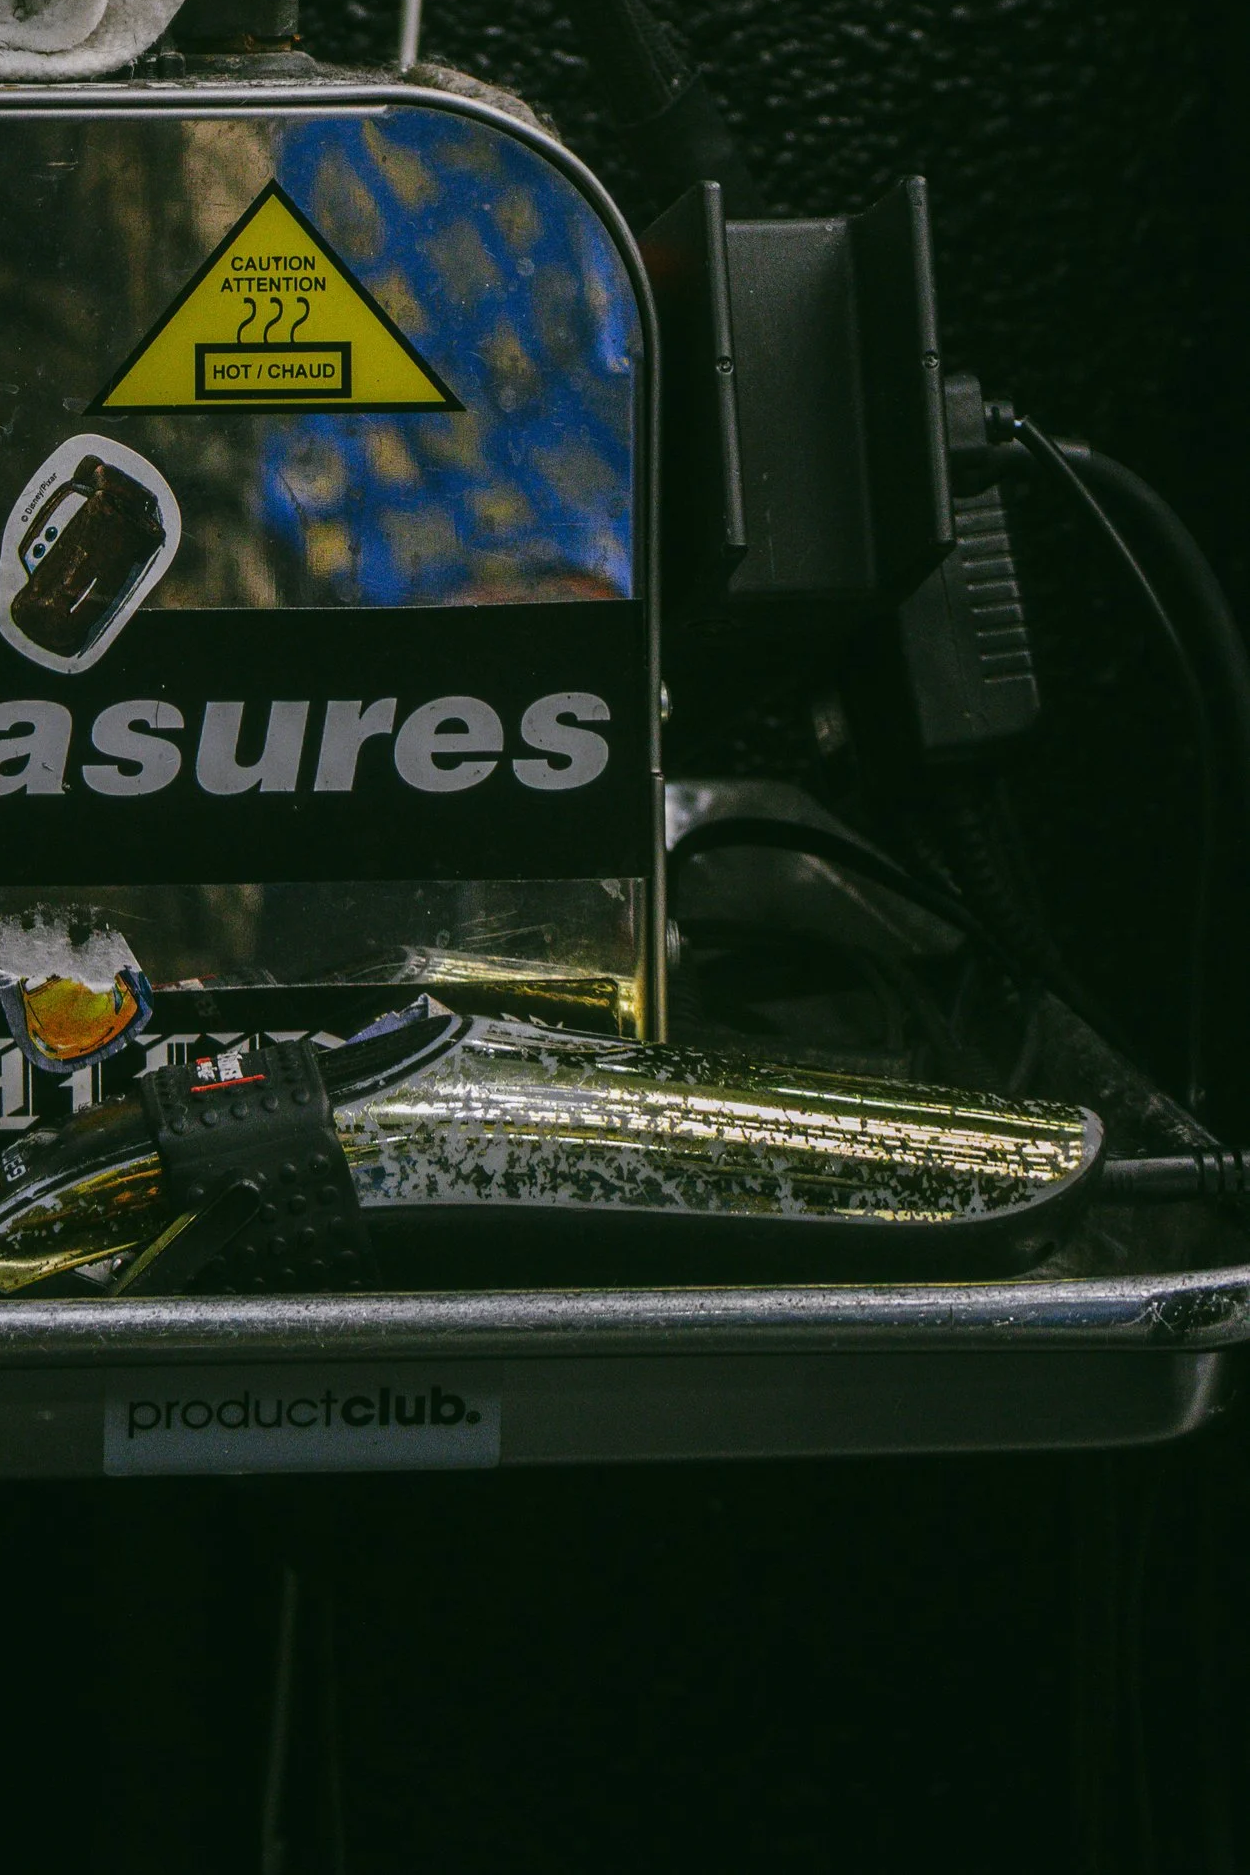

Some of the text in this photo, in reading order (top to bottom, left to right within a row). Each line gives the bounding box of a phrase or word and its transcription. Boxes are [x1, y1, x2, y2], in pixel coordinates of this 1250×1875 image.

[230, 255, 317, 272] CAUTION
[220, 276, 327, 293] ATTENTION
[212, 364, 250, 380] HOT
[267, 363, 336, 380] CHAUD
[25, 471, 58, 515] Disney/Pixar
